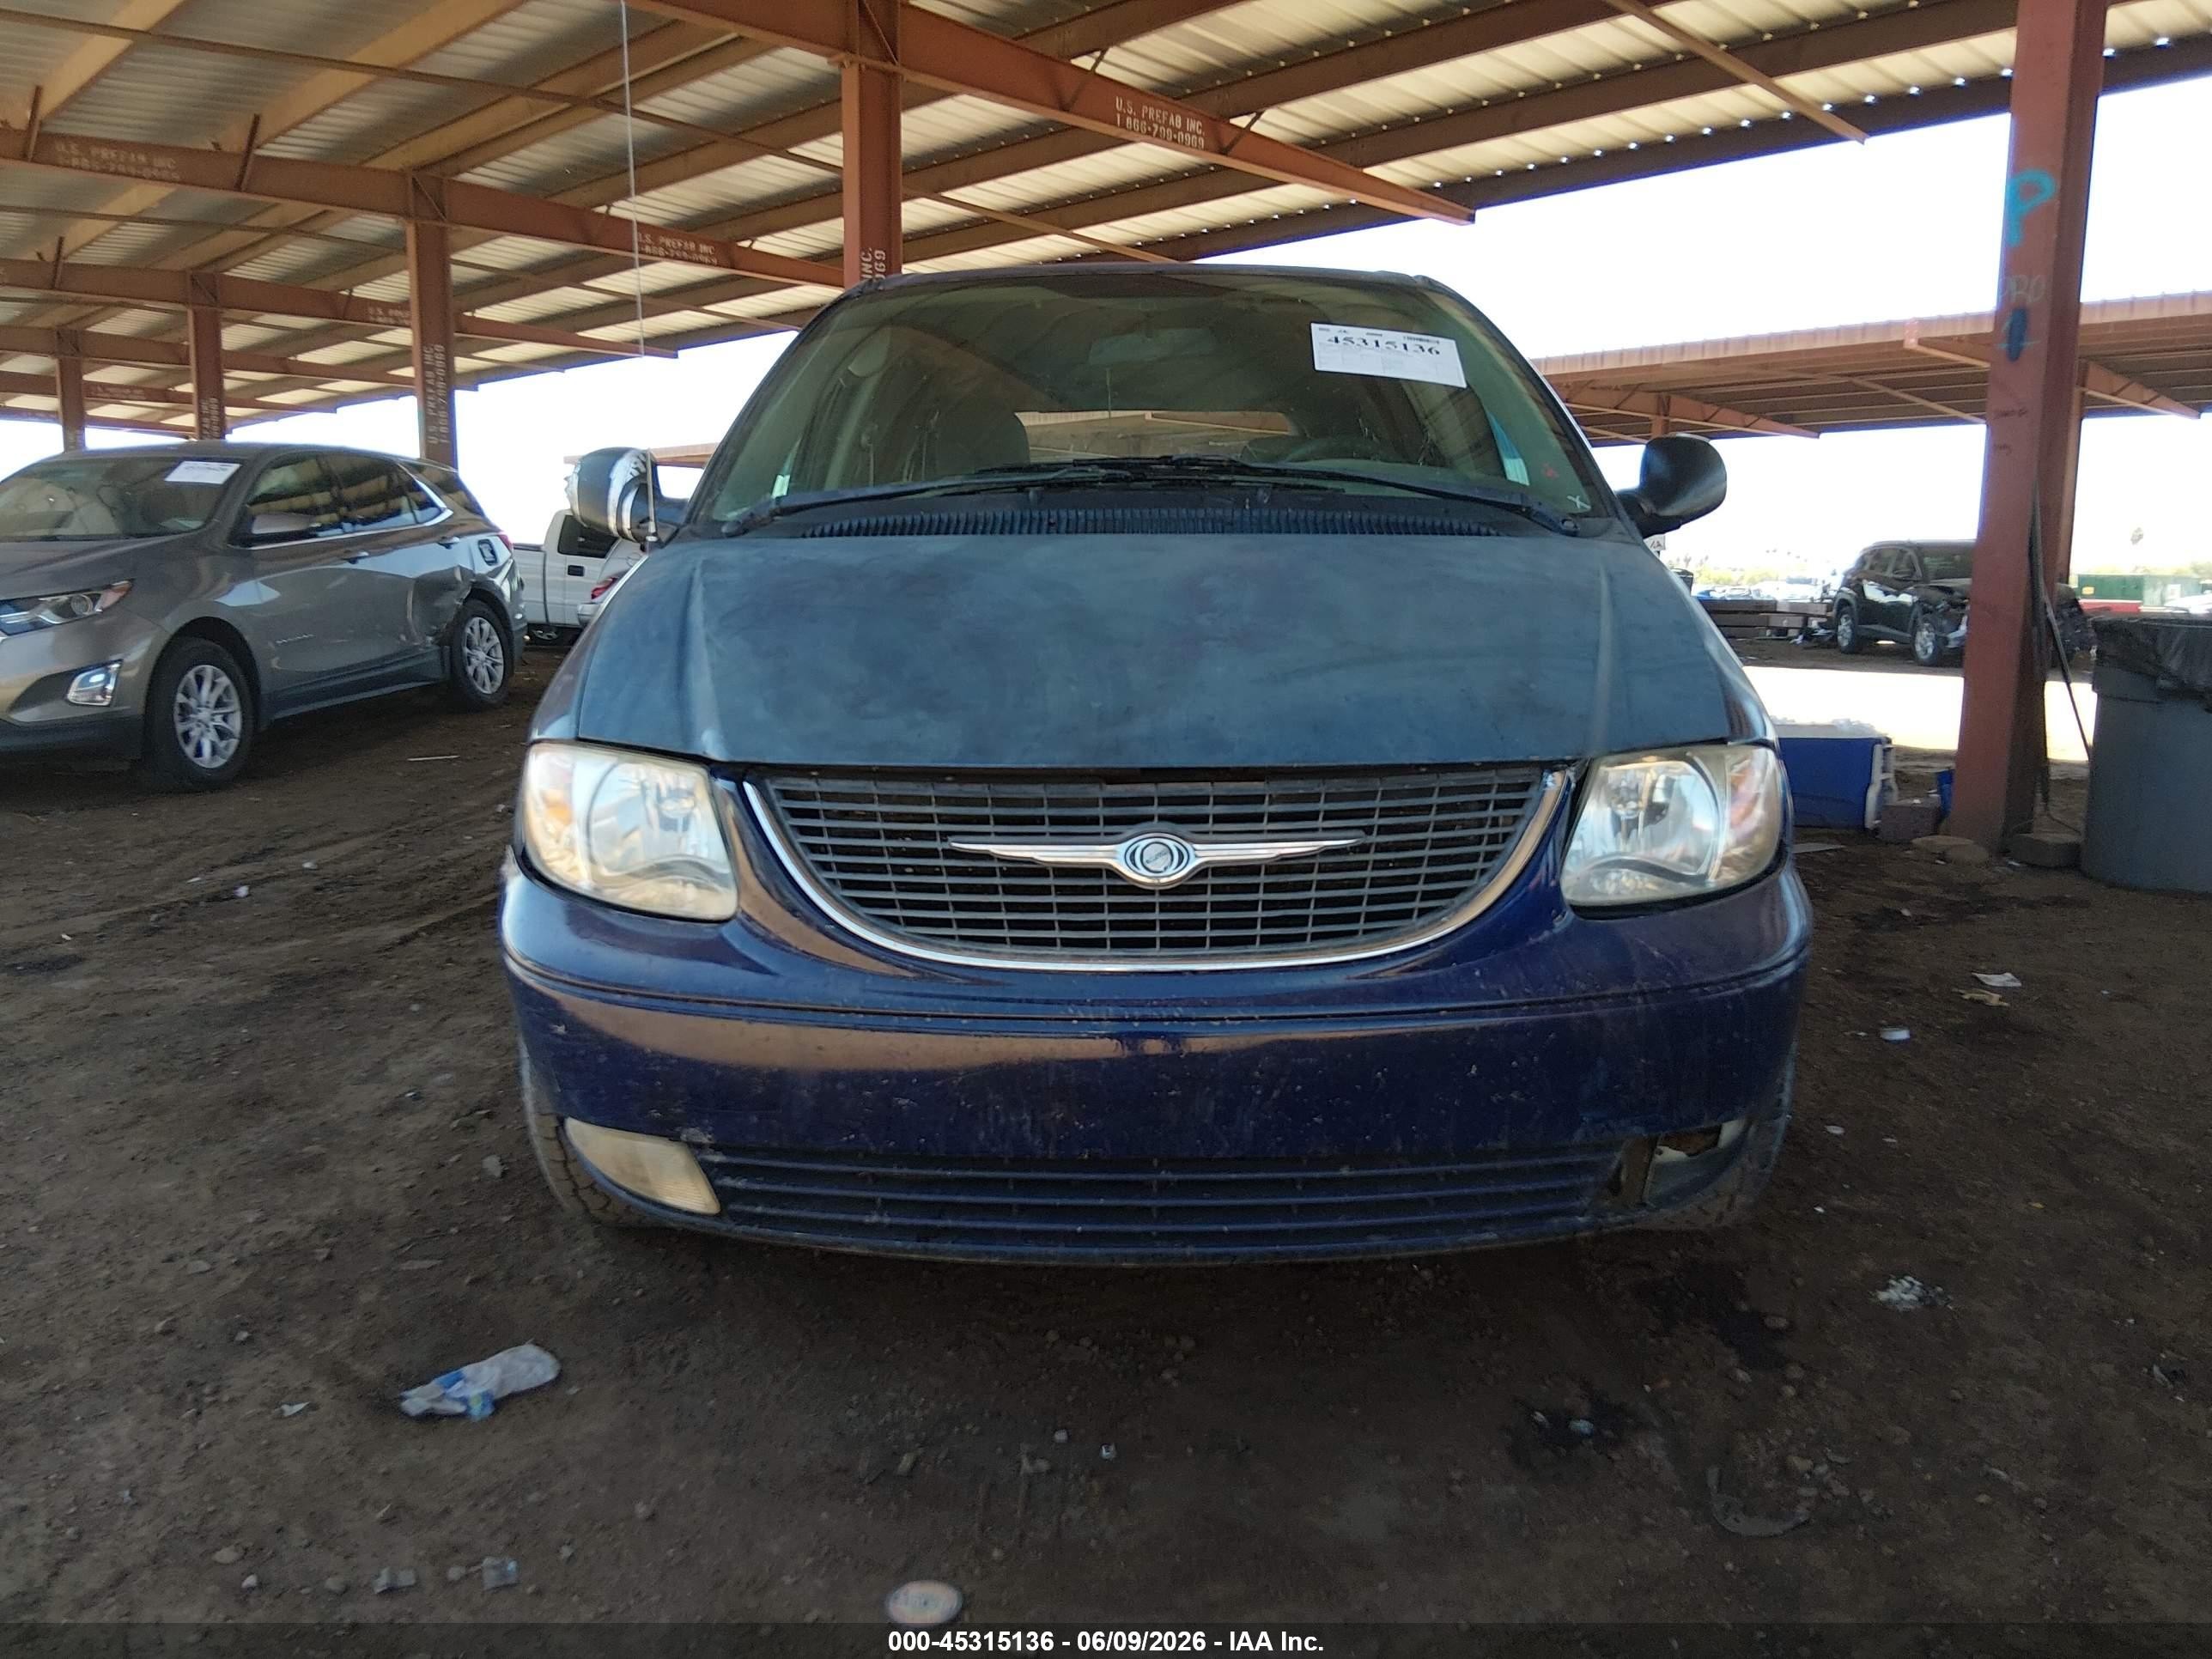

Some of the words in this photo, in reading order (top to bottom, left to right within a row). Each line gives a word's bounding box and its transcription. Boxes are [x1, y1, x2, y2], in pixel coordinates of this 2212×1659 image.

[1115, 96, 1136, 116] U.S.
[1141, 105, 1182, 129] PREFAB
[1187, 118, 1205, 137] INC.
[2005, 168, 2057, 247] P
[1327, 336, 1441, 356] 45315136
